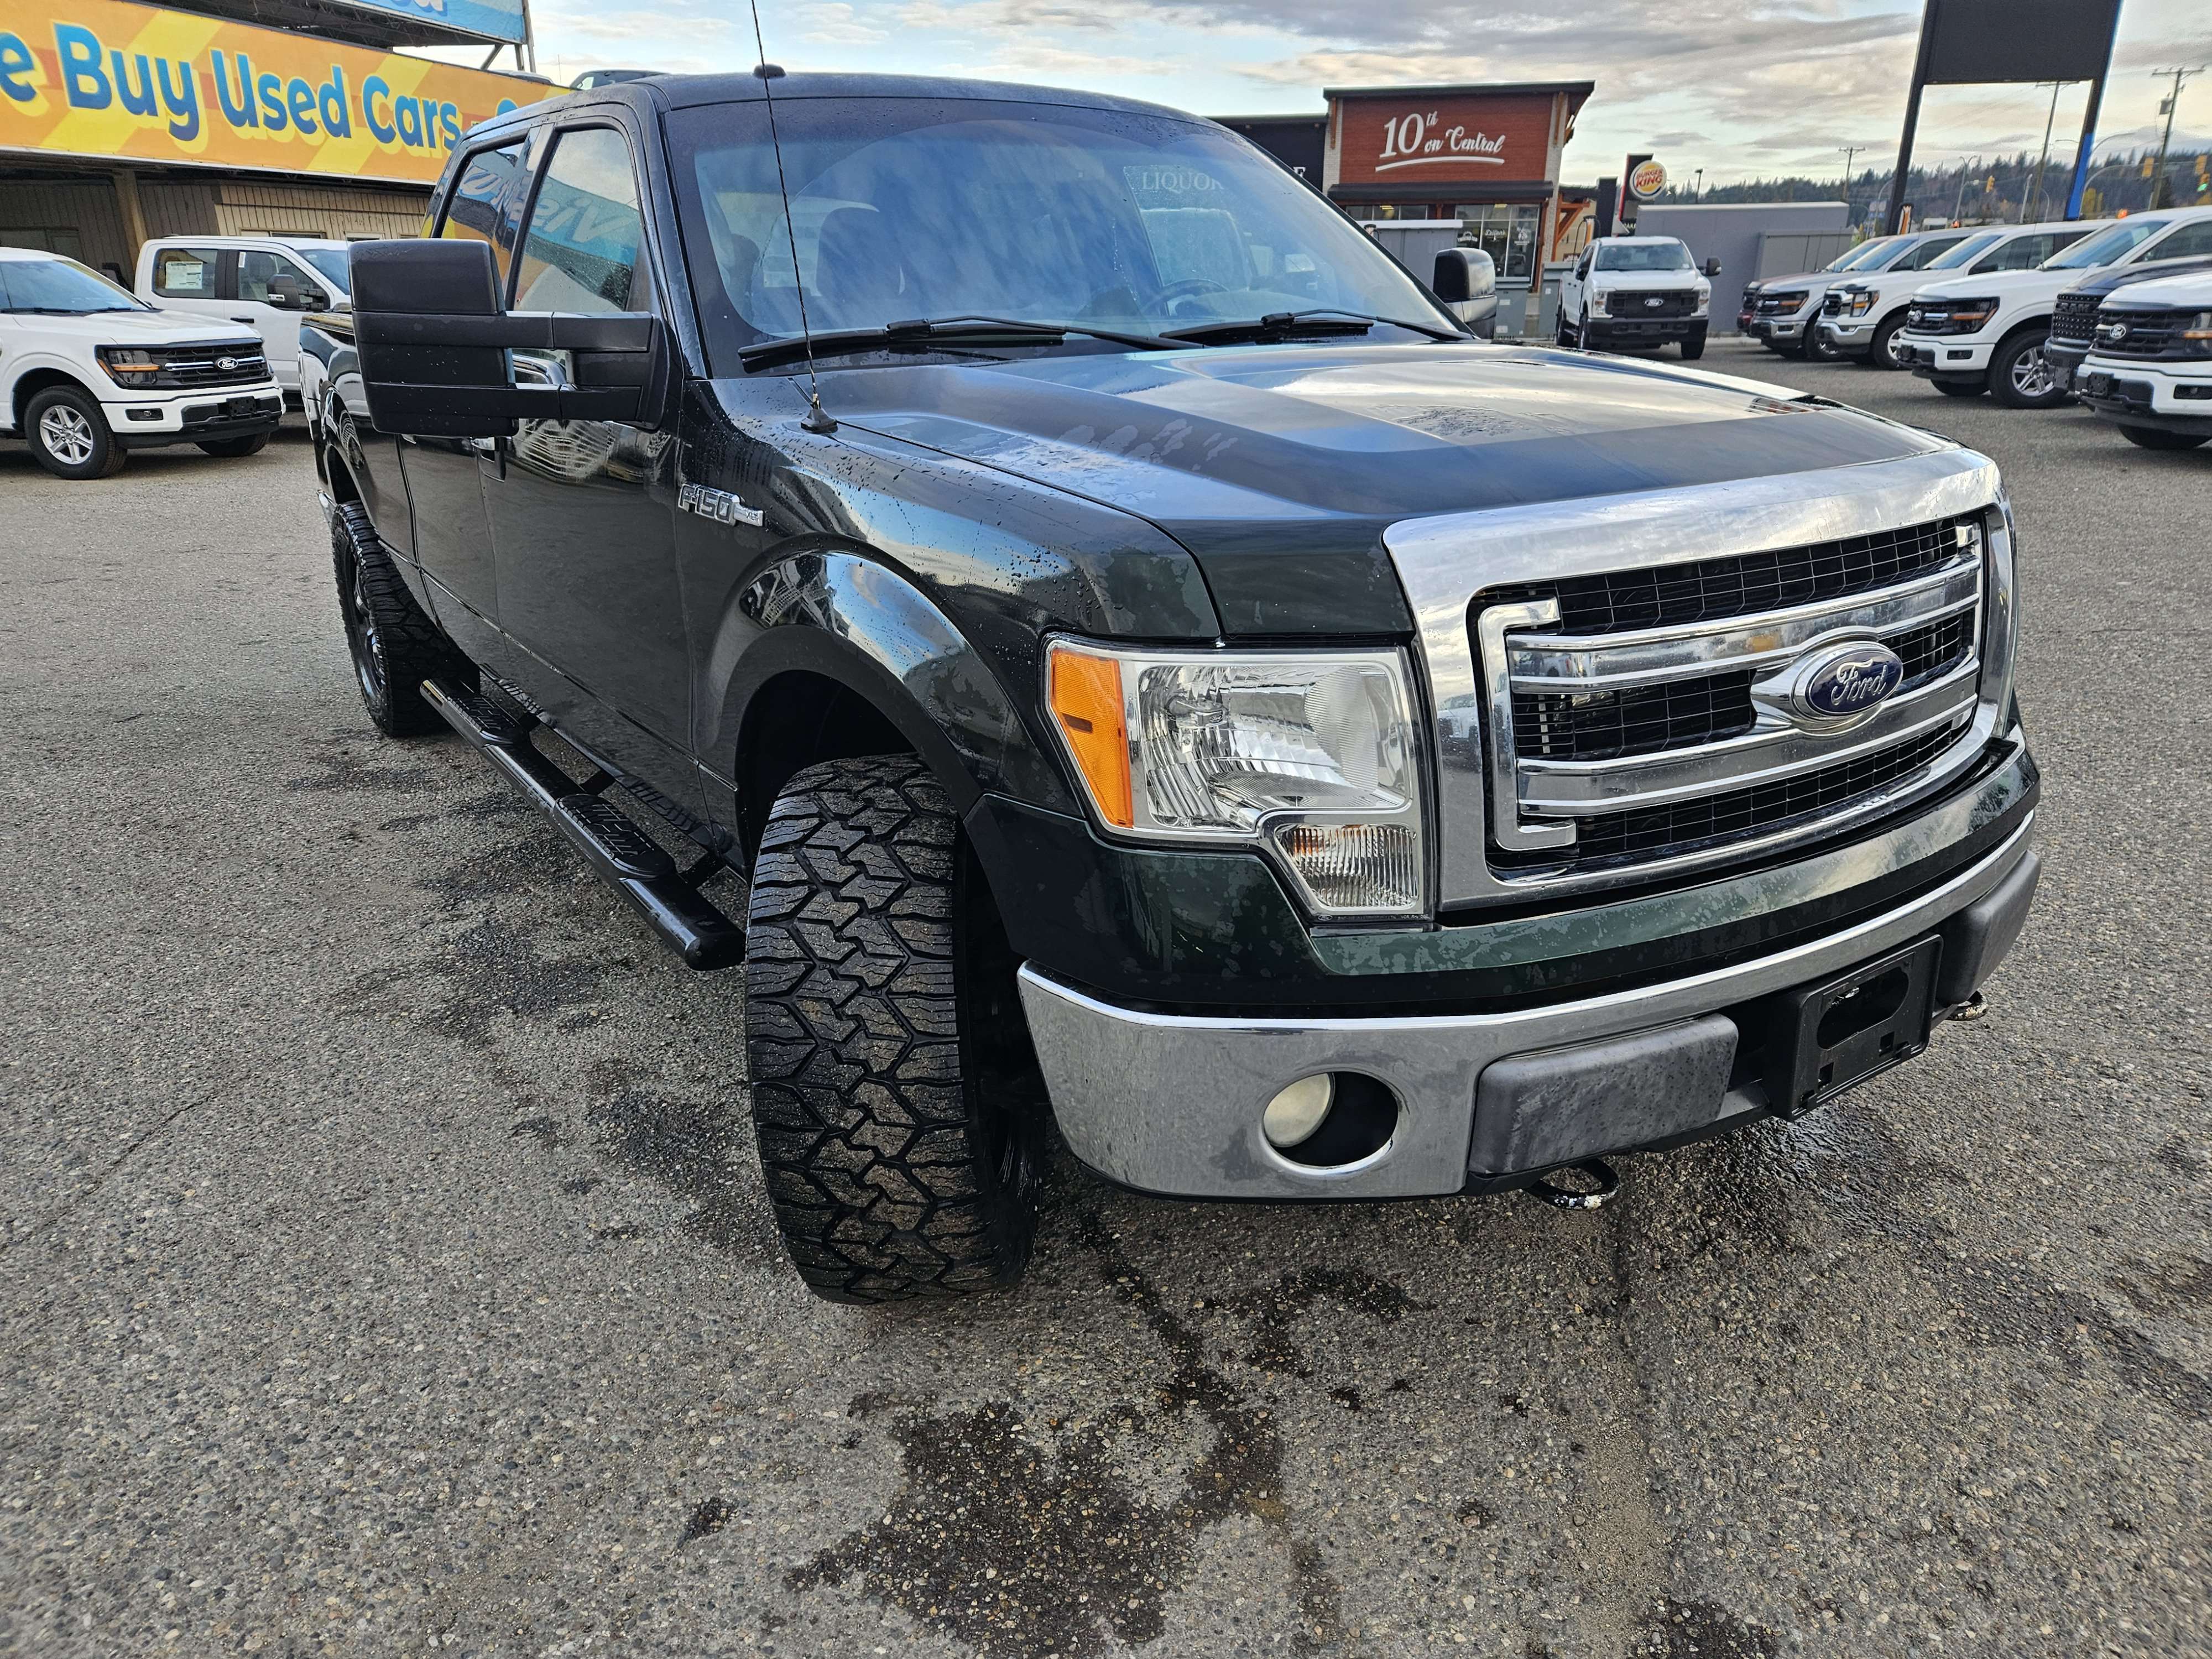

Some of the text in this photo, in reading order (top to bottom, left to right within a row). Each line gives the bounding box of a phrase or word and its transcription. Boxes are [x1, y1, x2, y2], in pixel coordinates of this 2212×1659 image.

[53, 22, 200, 142] Buy
[210, 49, 352, 139] Used
[362, 75, 462, 152] Cars
[1424, 138, 1444, 153] on
[1445, 126, 1506, 154] Central
[1636, 168, 1663, 179] BURGER
[1636, 176, 1662, 187] KING
[1831, 658, 1888, 706] Ford
